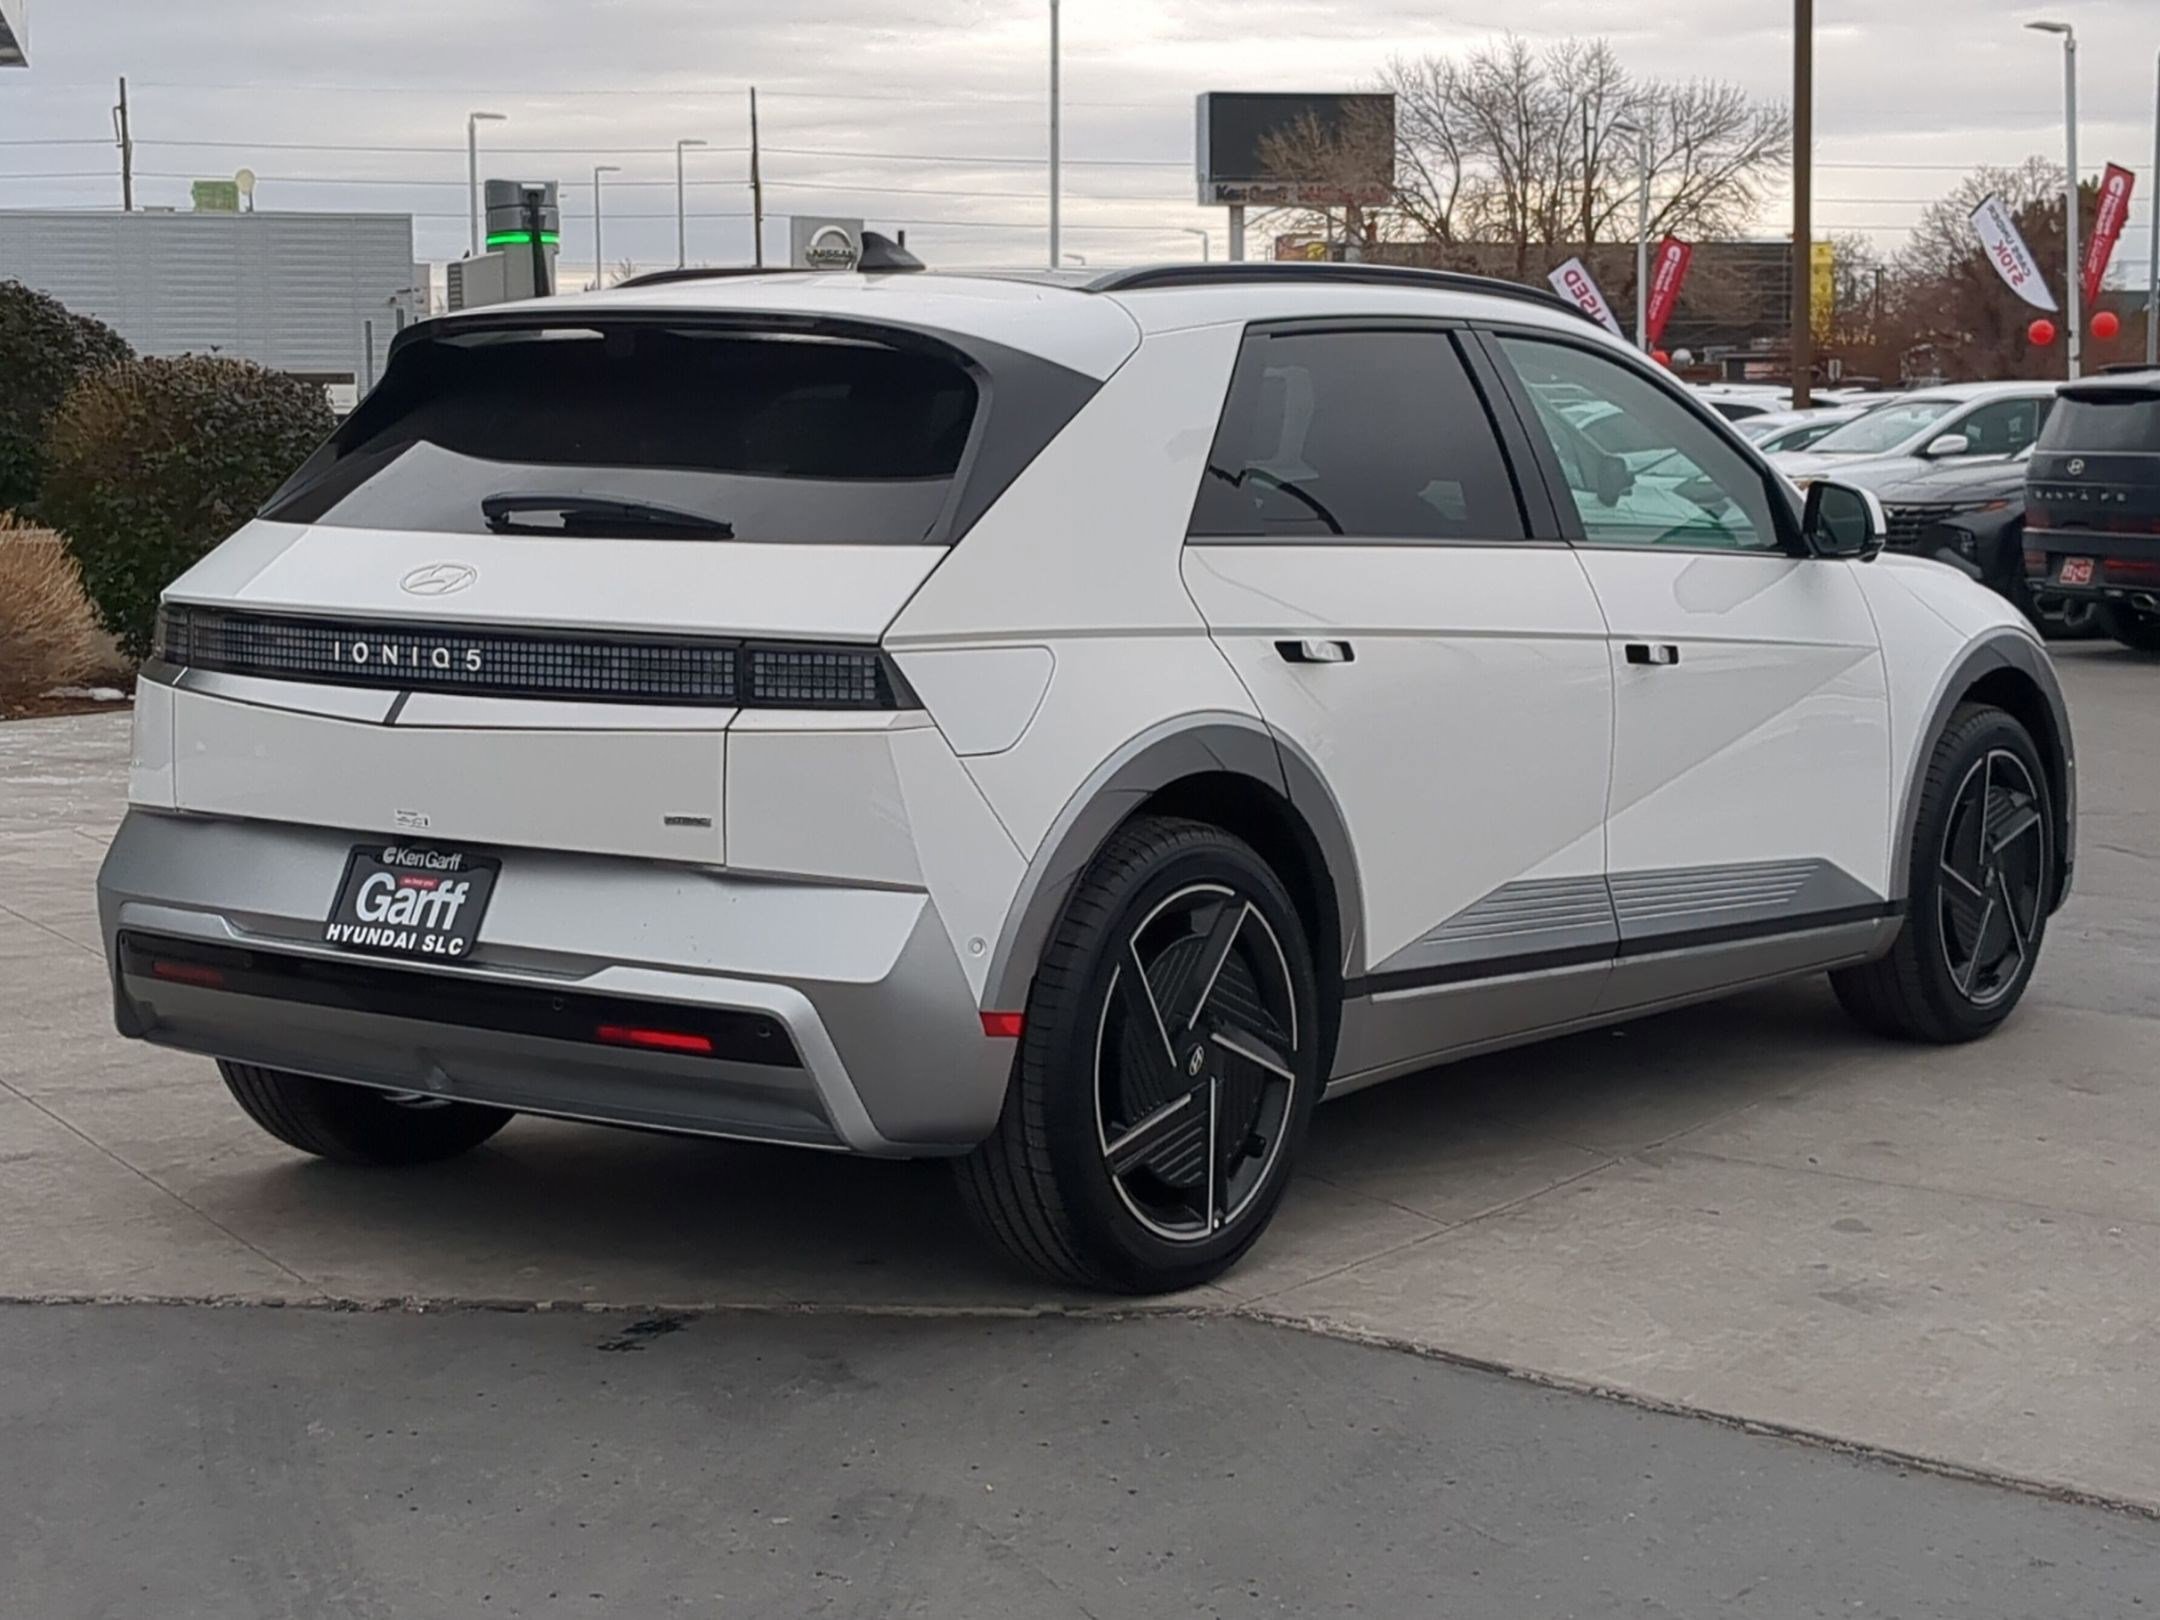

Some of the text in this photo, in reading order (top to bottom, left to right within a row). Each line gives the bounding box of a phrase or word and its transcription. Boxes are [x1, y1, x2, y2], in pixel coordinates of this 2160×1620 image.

[333, 640, 482, 672] IONIQ 5
[396, 848, 463, 871] Ken Garff
[355, 872, 470, 931] Garff
[325, 923, 464, 956] HYUNDAI SLC
